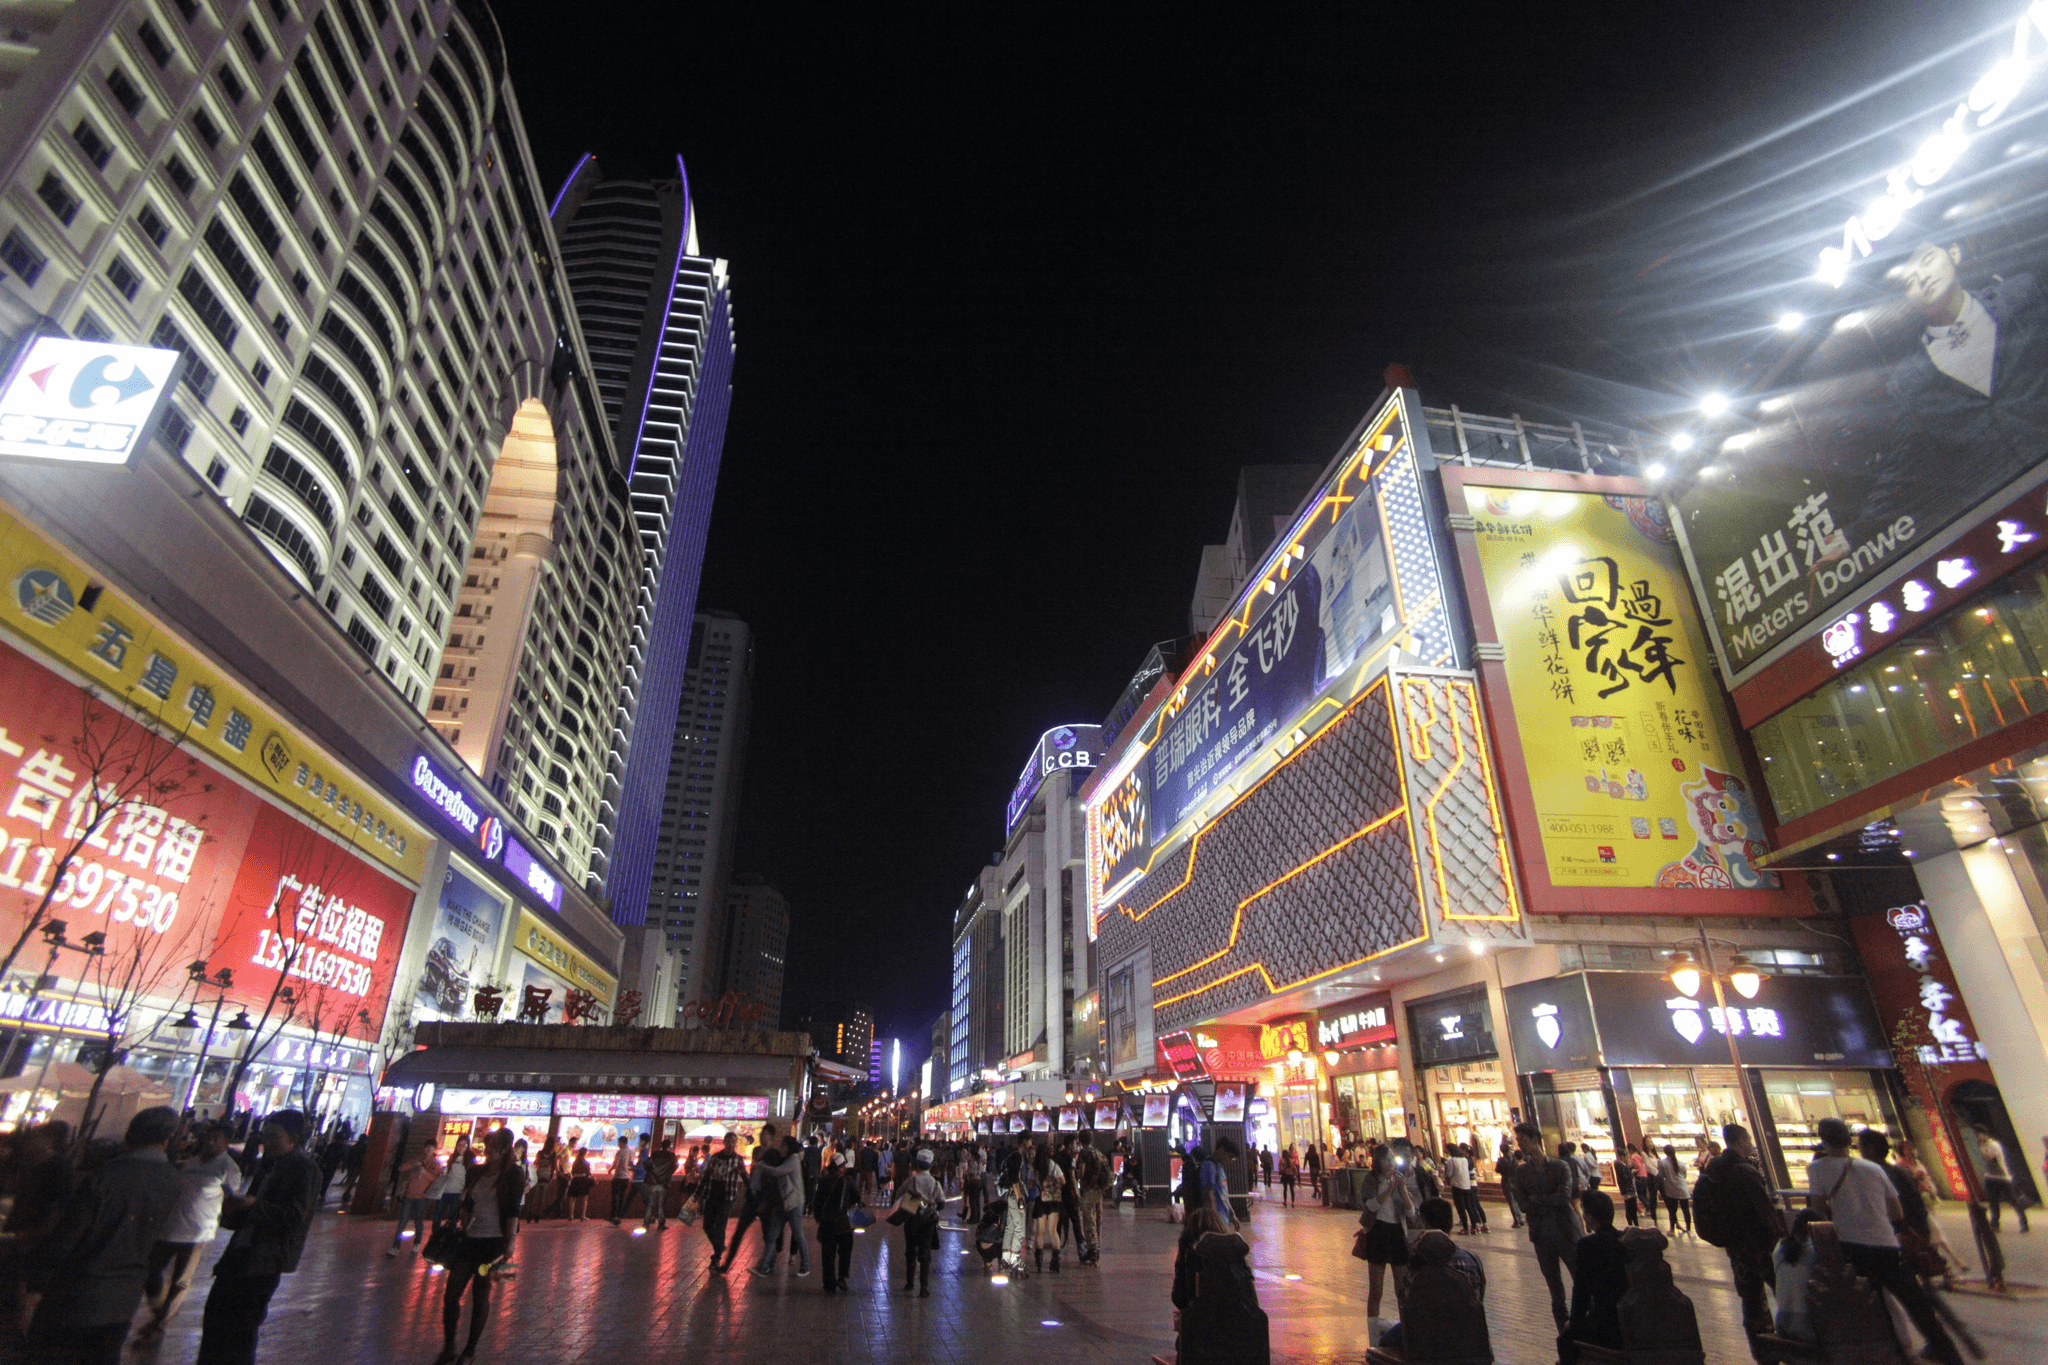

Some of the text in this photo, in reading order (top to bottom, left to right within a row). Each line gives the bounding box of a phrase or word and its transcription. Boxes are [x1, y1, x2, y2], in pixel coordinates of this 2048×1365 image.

[1716, 491, 1850, 625] 混出范
[1731, 591, 1810, 659] Meters
[1815, 515, 1916, 598] bonwe
[87, 618, 253, 754] 五星电器
[1045, 751, 1090, 771] CCB
[1154, 678, 1222, 791] 普瑞眼科
[413, 755, 479, 834] Carrefour
[265, 873, 386, 961] 广告位招租
[252, 929, 373, 998] 13211697530
[682, 990, 766, 1026] coffee
